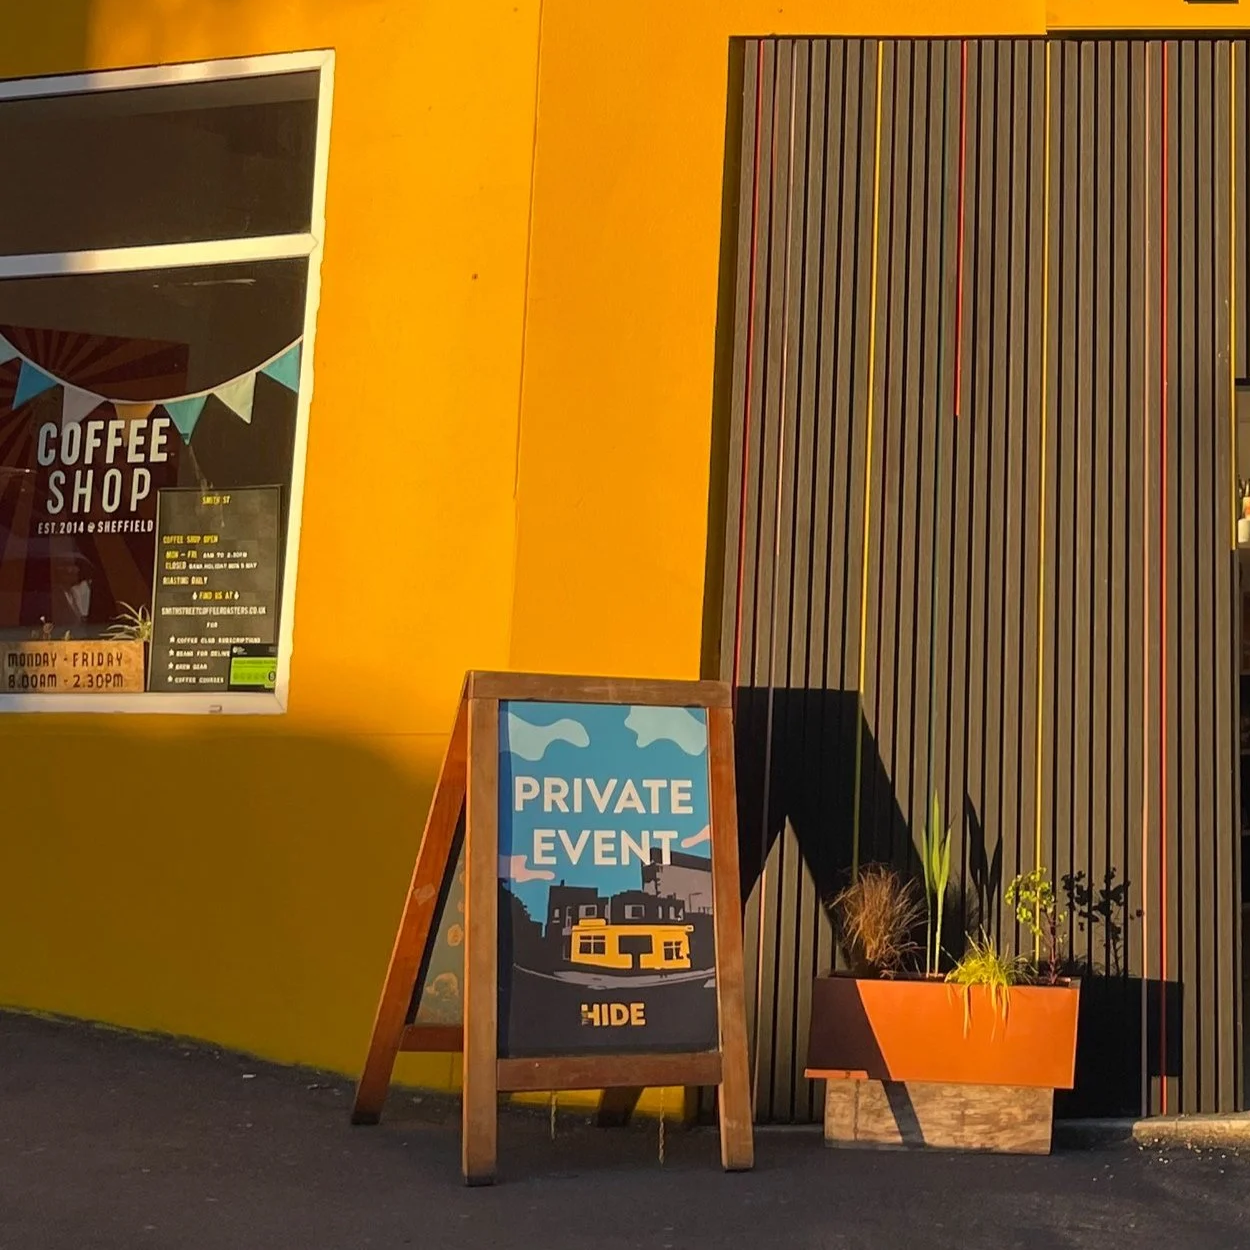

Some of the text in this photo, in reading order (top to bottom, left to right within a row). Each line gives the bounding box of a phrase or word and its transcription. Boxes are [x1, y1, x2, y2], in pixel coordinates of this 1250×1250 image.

[37, 418, 171, 467] COFFEE
[46, 468, 152, 515] SHOP
[97, 519, 154, 533] SHEFFIELD
[163, 535, 184, 544] COFFEE
[186, 535, 201, 544] SHOP
[8, 653, 58, 667] MONDAY
[72, 653, 124, 667] FRIDAY
[72, 674, 124, 688] 2.30PM
[514, 776, 694, 815] PRIVATE
[533, 829, 679, 866] EVENT
[581, 1003, 646, 1026] HIDE
